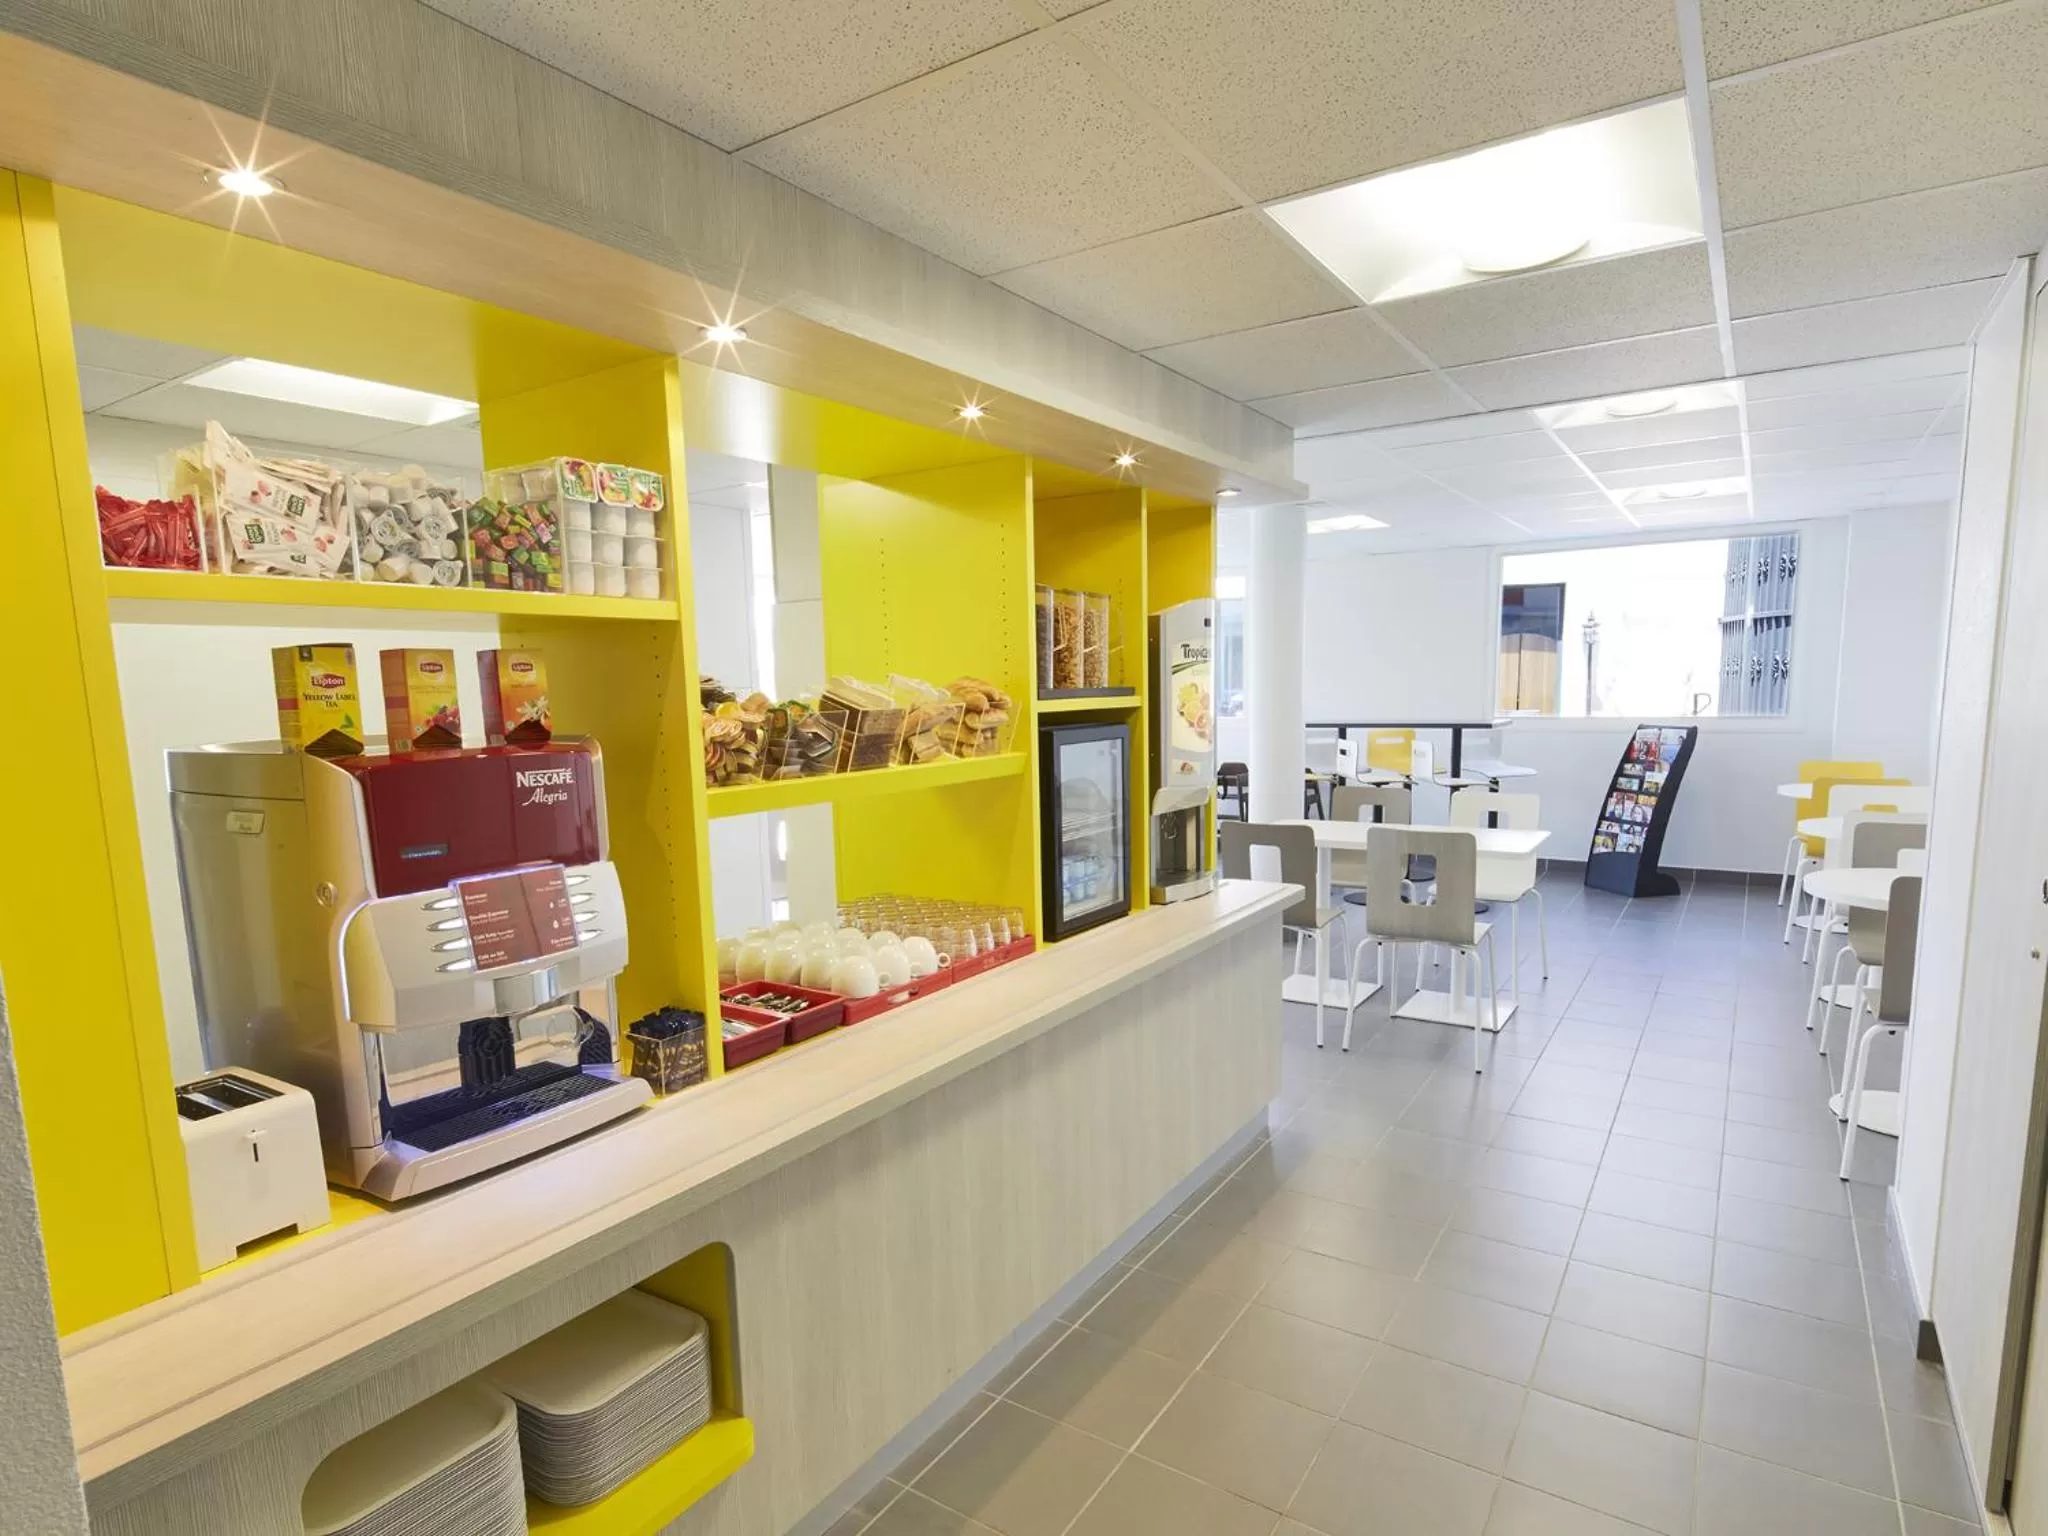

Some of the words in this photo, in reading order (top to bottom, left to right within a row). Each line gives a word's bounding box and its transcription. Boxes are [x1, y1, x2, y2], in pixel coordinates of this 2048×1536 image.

[313, 677, 344, 687] Lipton
[516, 768, 574, 788] NESCAFÉ
[522, 788, 568, 806] Alegria
